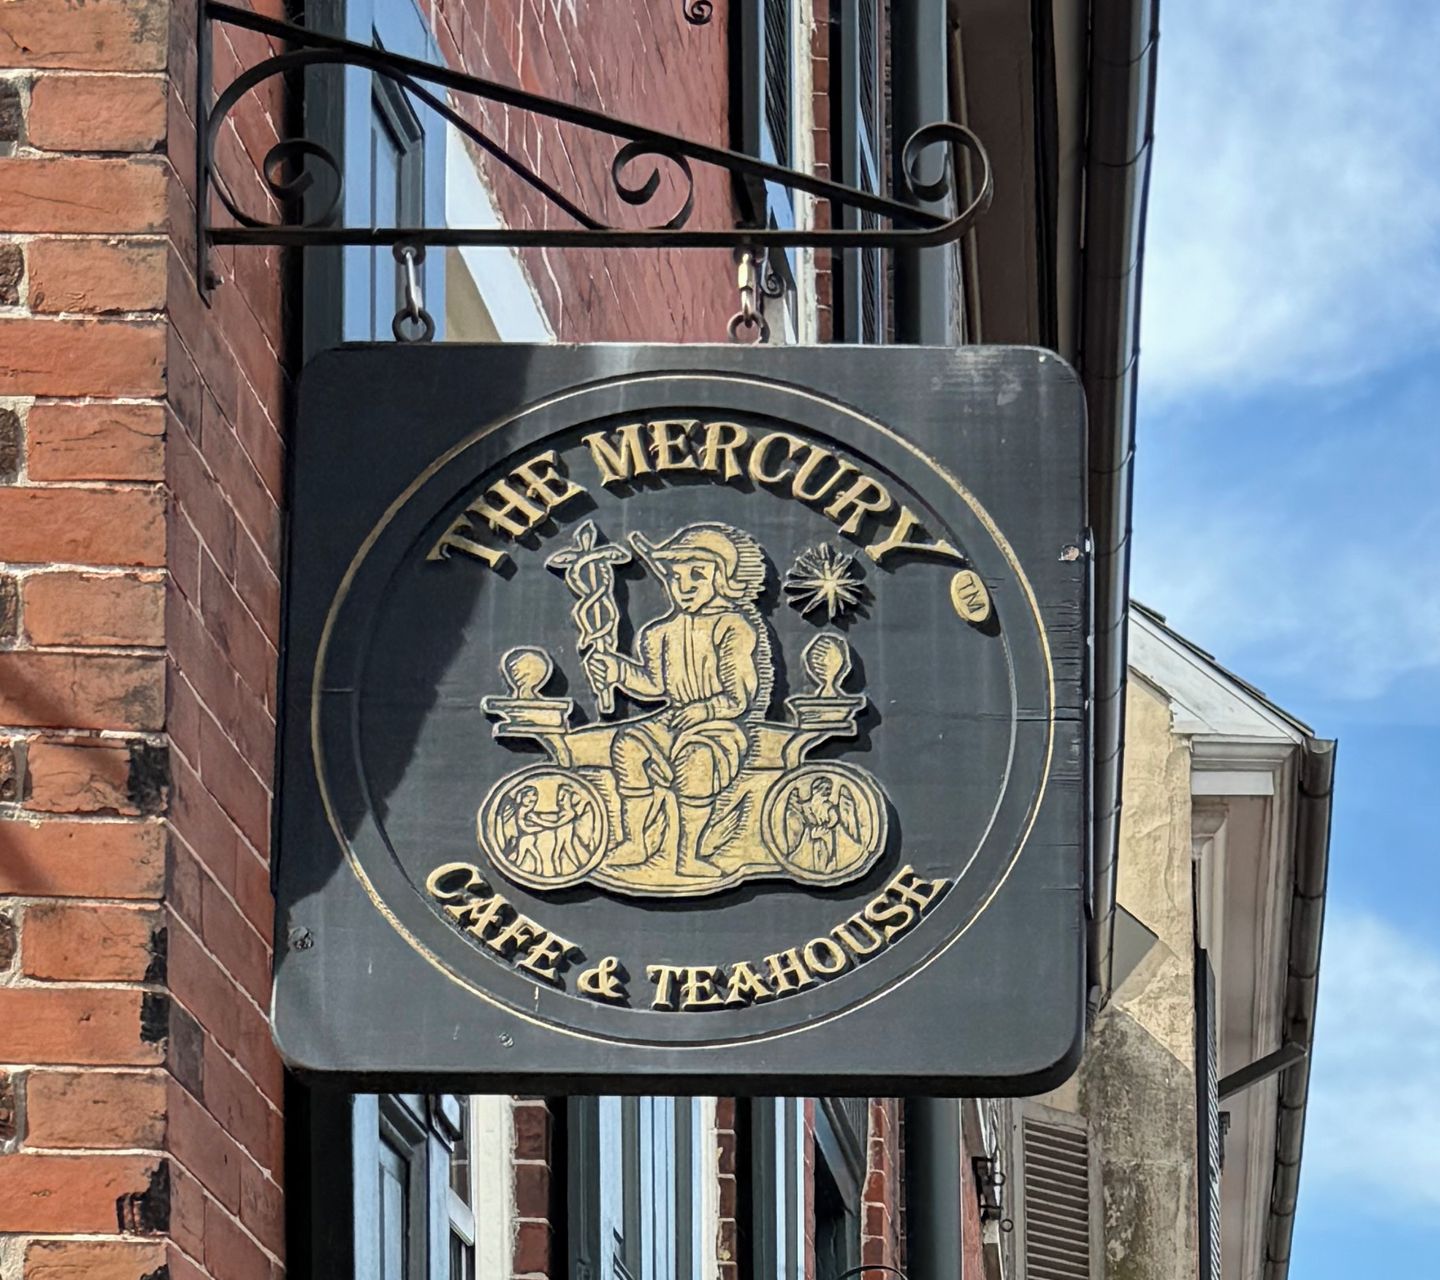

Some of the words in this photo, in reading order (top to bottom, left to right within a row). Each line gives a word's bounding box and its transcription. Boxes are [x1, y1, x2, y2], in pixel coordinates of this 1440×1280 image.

[425, 449, 588, 579] THE
[581, 418, 966, 566] MERCURY
[957, 573, 985, 613] TM
[424, 861, 581, 981] CAFE
[577, 956, 625, 1000] &
[646, 864, 953, 1011] TEAHOUSE
